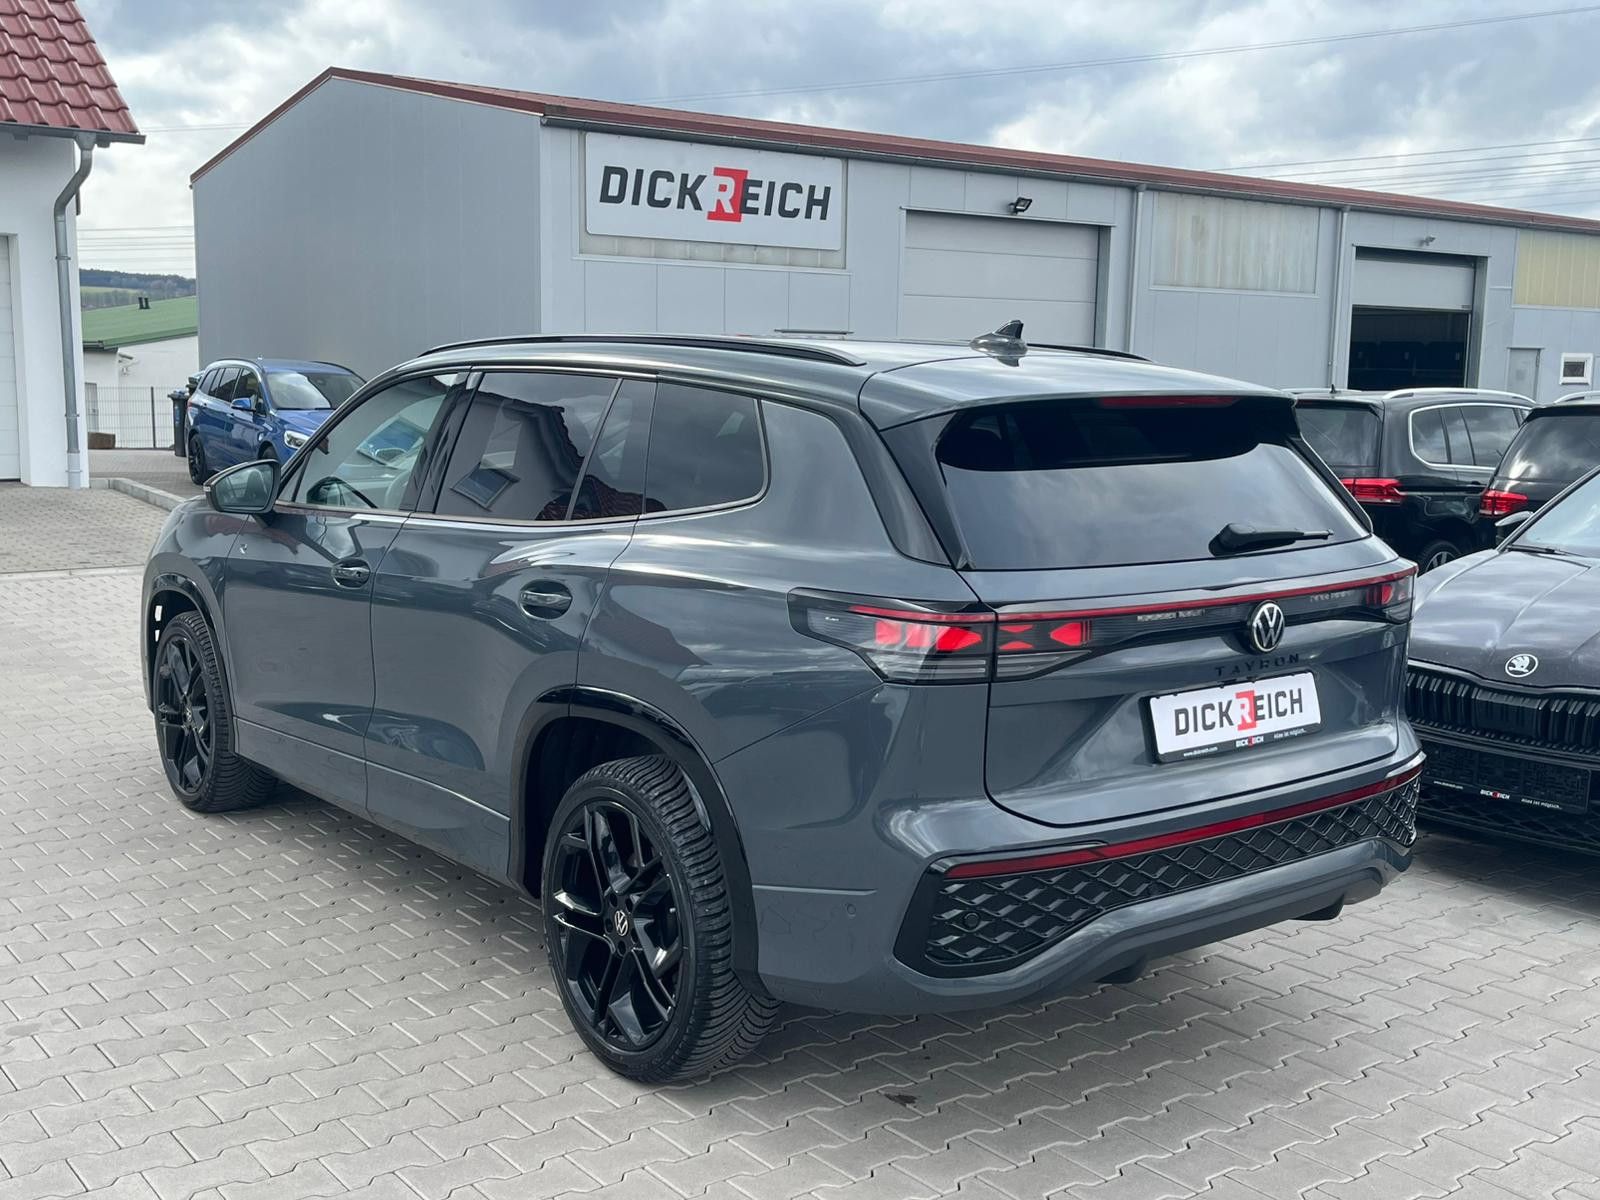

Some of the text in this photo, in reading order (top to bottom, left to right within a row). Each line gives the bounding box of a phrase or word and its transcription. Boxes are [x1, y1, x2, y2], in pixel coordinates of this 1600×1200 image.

[600, 165, 831, 223] DICKREICH
[1215, 653, 1300, 677] TAYRON
[1174, 688, 1303, 736] DICKREICH
